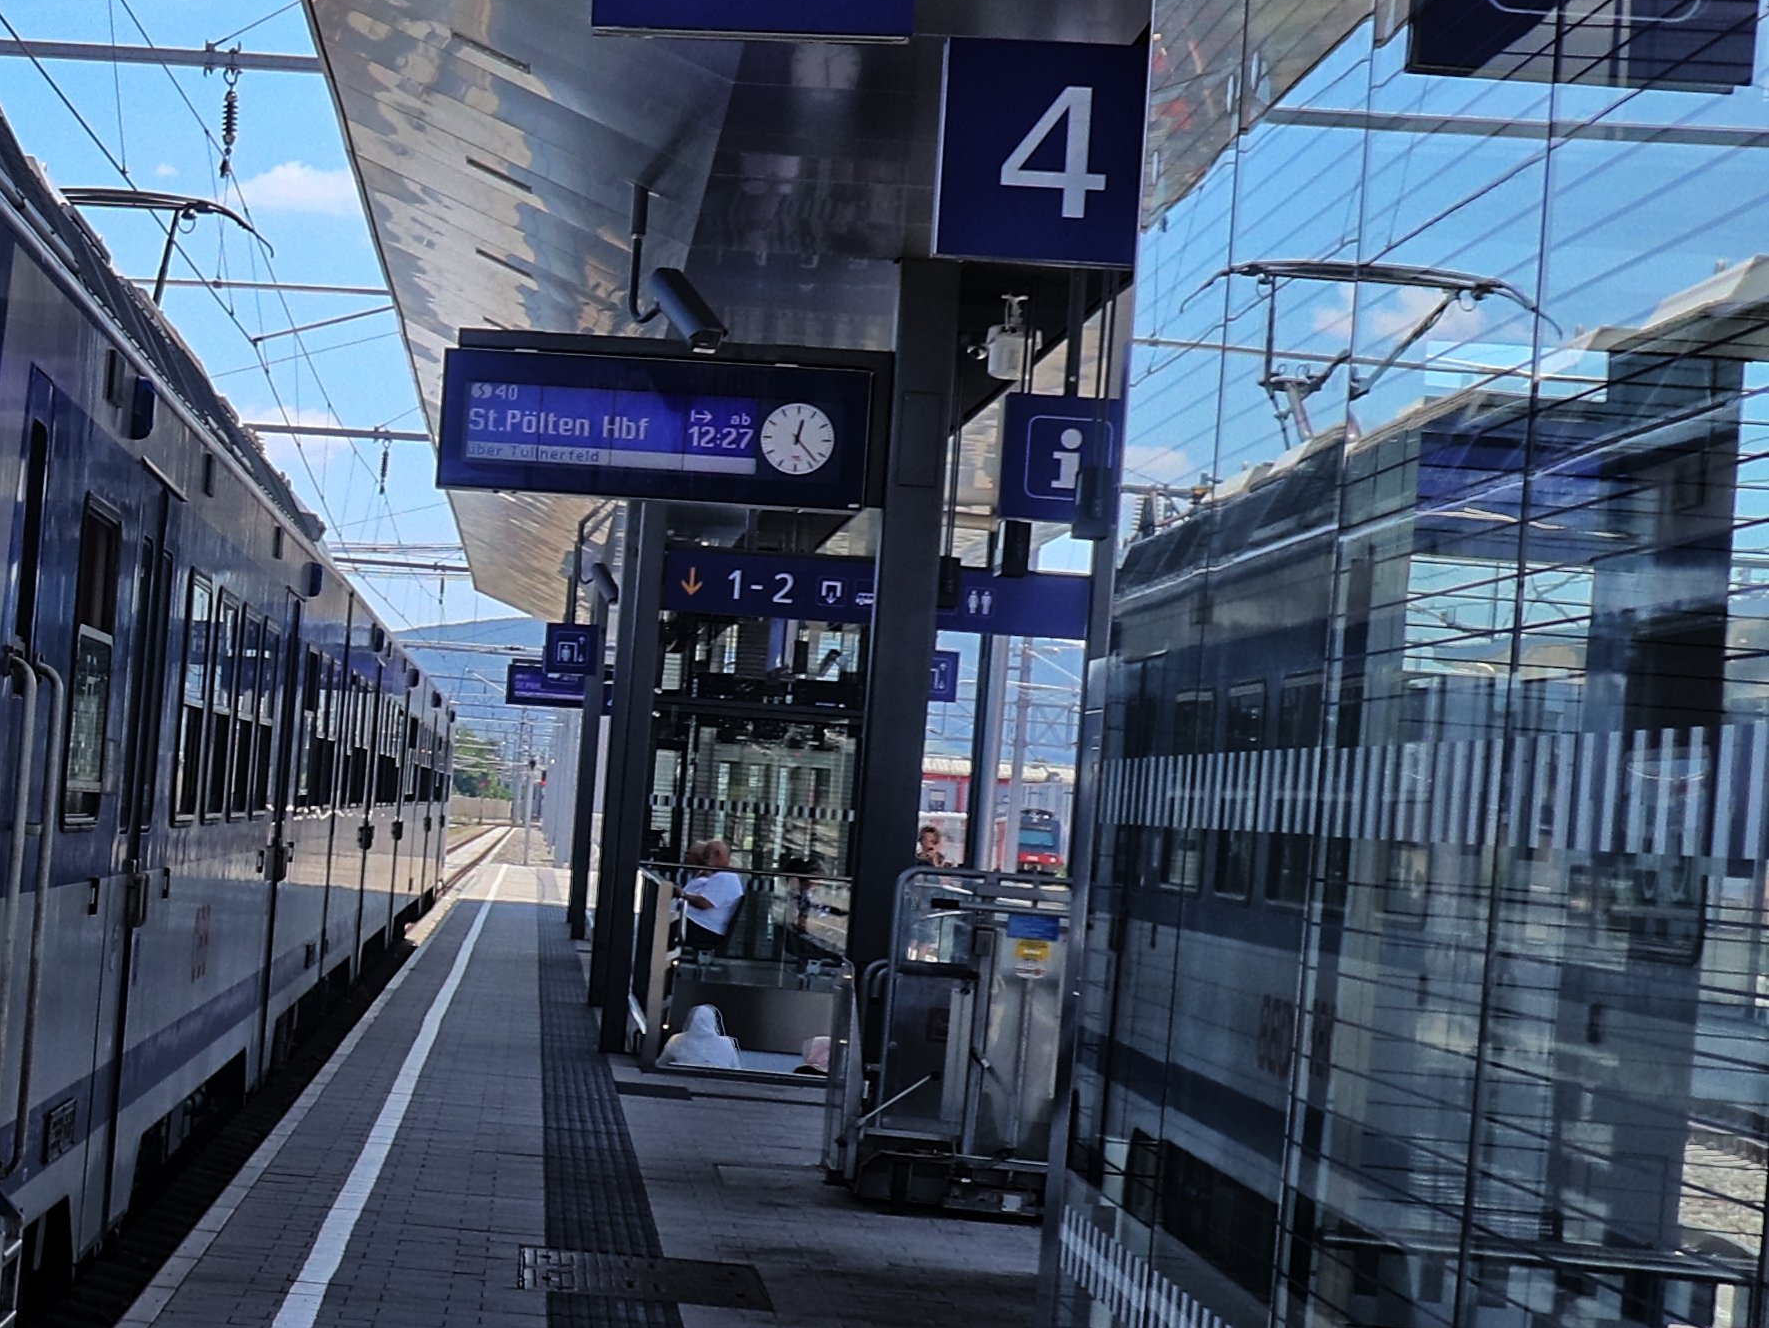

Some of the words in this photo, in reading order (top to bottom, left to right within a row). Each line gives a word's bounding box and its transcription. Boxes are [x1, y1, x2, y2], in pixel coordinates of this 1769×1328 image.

[1000, 85, 1107, 219] 4
[468, 407, 591, 437] St.Pölten
[602, 415, 650, 441] Hbf
[730, 412, 751, 426] ab
[687, 425, 755, 450] 12:27
